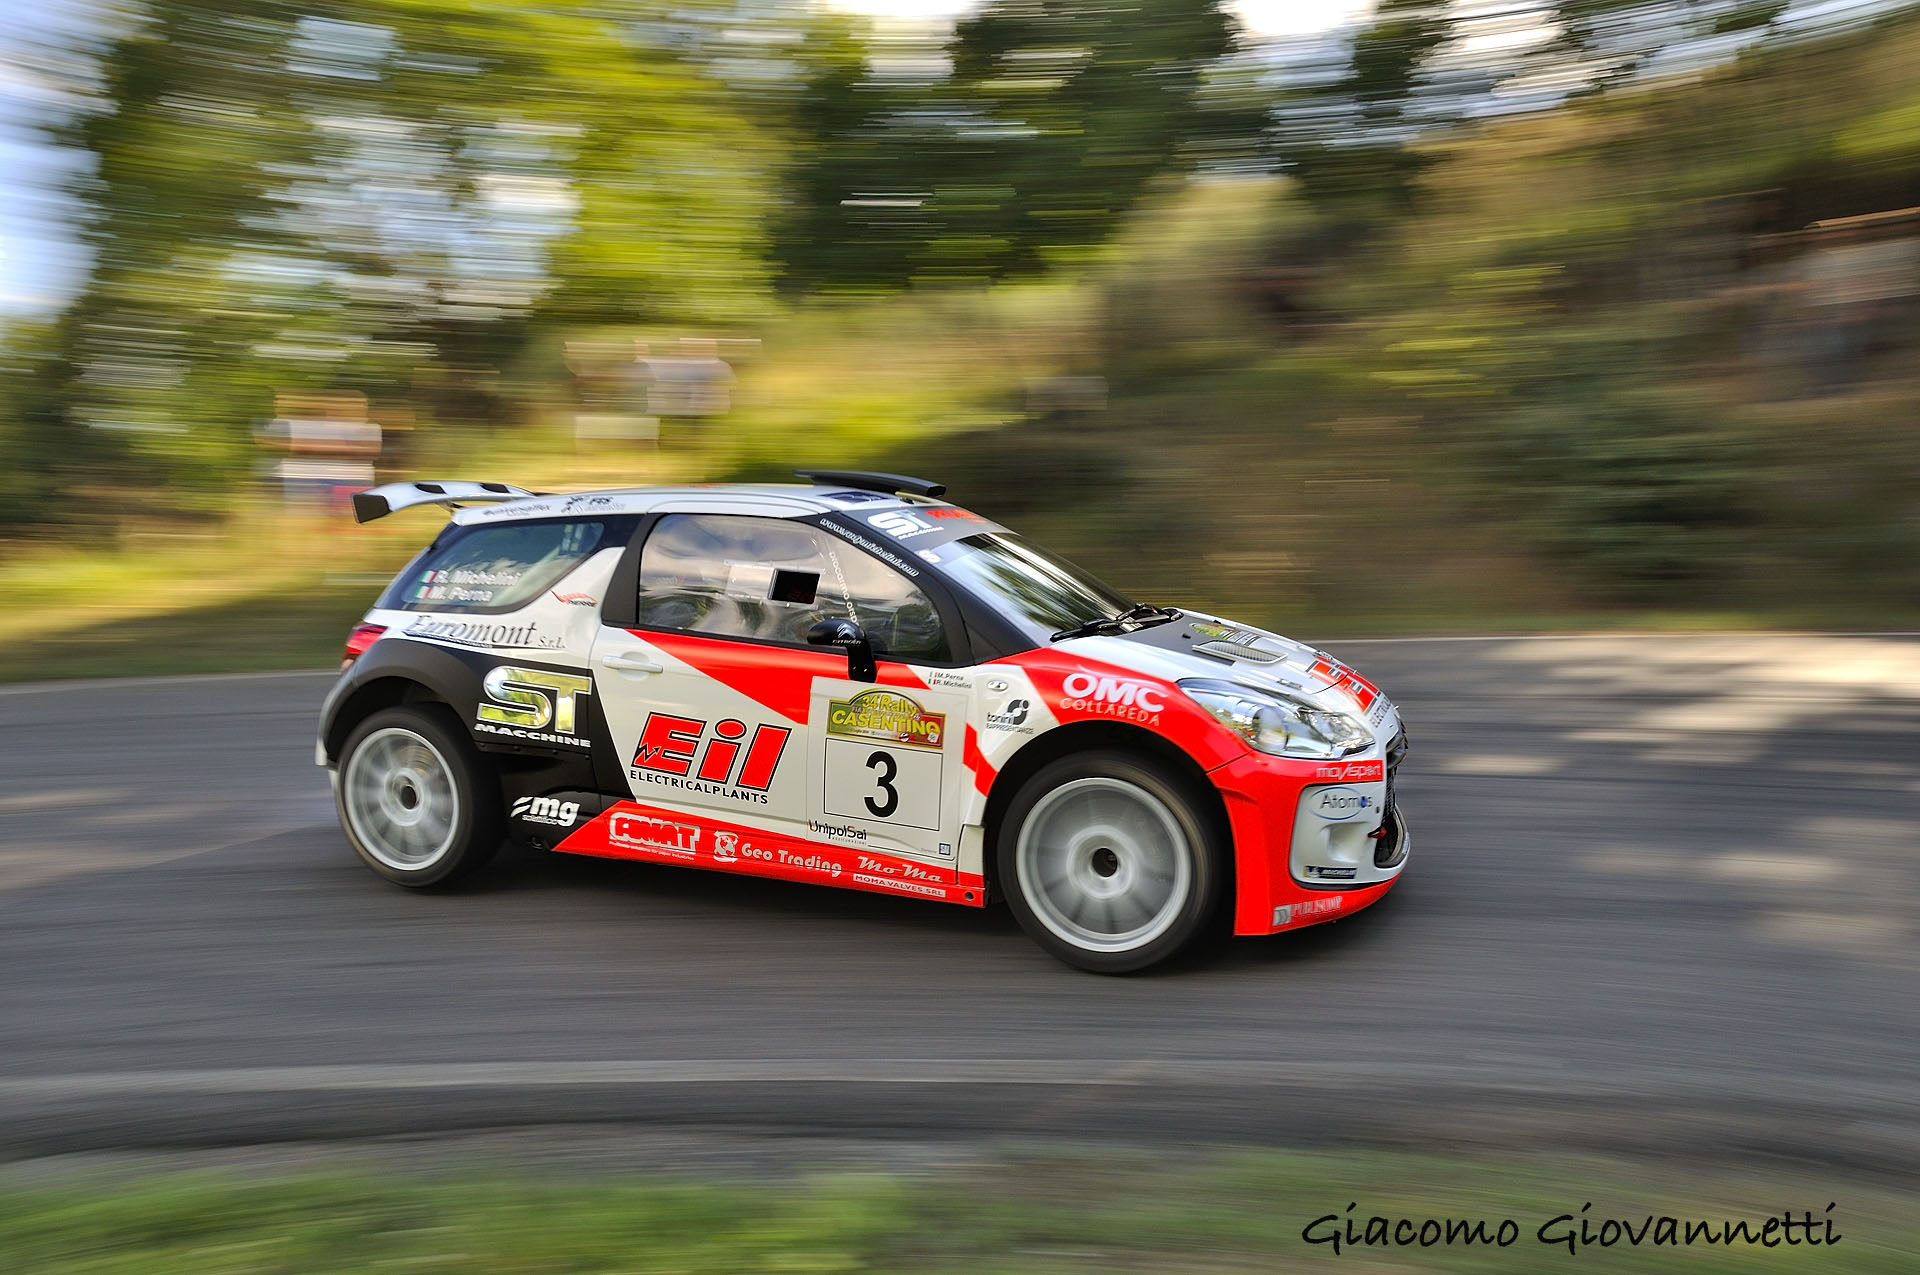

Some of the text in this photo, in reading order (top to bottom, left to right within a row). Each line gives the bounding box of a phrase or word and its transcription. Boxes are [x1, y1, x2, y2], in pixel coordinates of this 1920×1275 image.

[410, 614, 537, 646] Euromont
[476, 665, 593, 735] ST
[879, 694, 918, 717] Rally
[1062, 672, 1168, 713] OMC
[831, 710, 941, 736] CASENTINO
[1060, 697, 1160, 727] COLLAREDA
[473, 723, 592, 748] MACCHINE
[629, 769, 769, 805] ELECTRICALPLANTS
[863, 750, 899, 818] 3
[529, 796, 581, 827] mg
[807, 819, 868, 840] UnipolSai
[741, 842, 843, 878] Geo Trading
[854, 874, 944, 896] MOMA VALVES SRL
